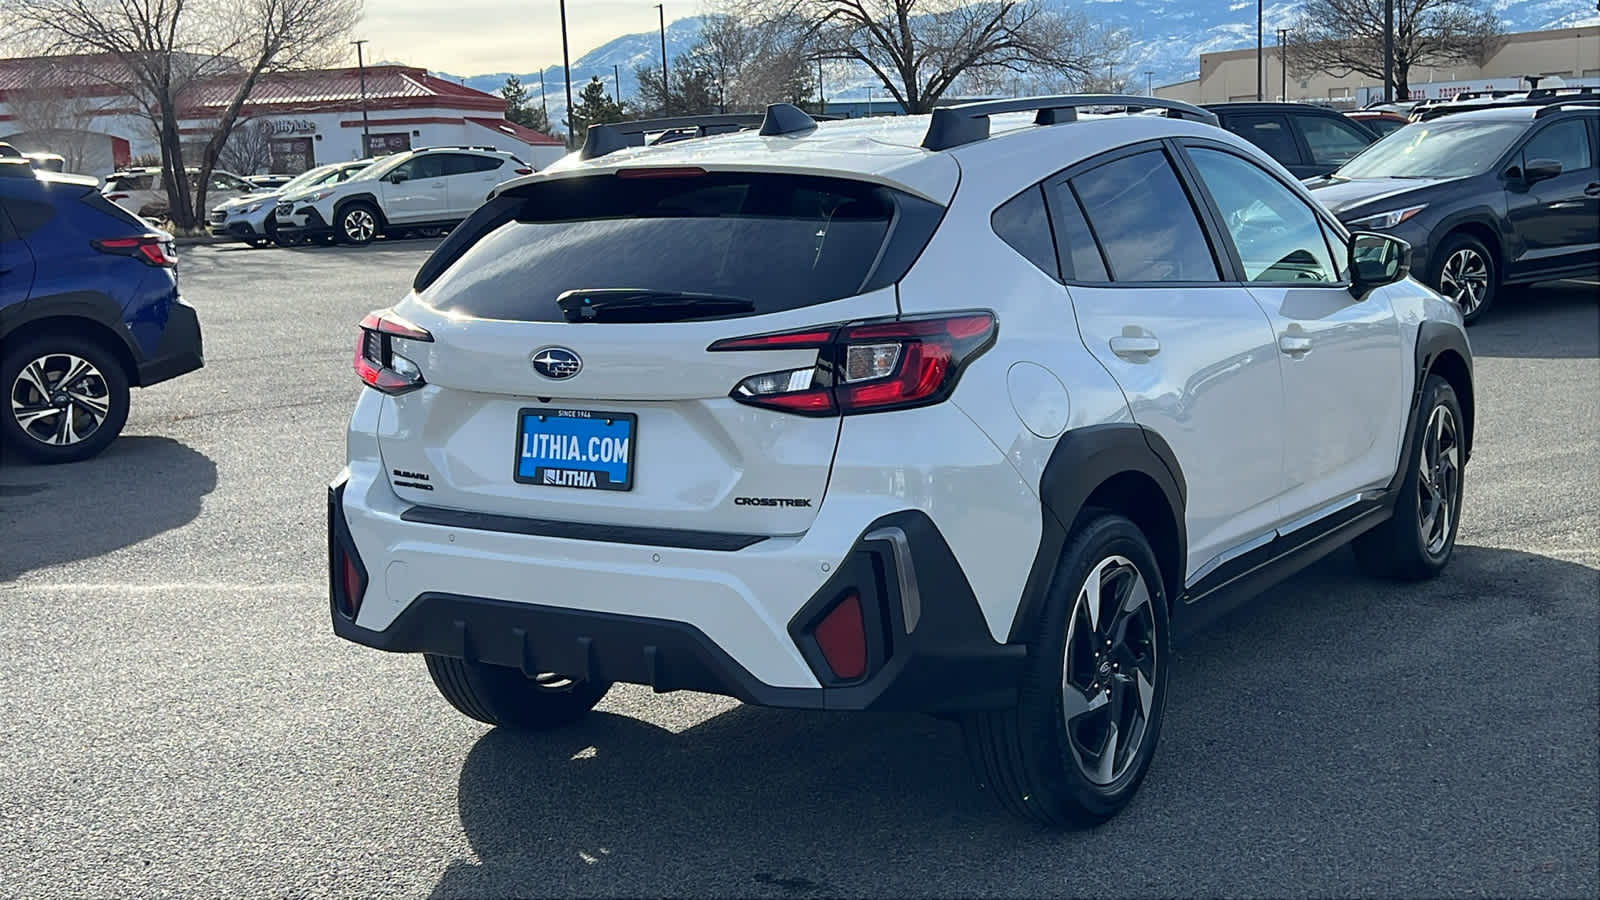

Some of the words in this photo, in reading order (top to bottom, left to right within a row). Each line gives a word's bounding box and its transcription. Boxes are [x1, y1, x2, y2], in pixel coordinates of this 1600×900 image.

[558, 410, 577, 418] SINCE
[577, 410, 592, 418] 1946
[522, 433, 629, 464] LITHIA.COM
[393, 469, 430, 481] SUBARU
[555, 469, 597, 488] LITHIA
[734, 497, 811, 507] CROSSTREK
